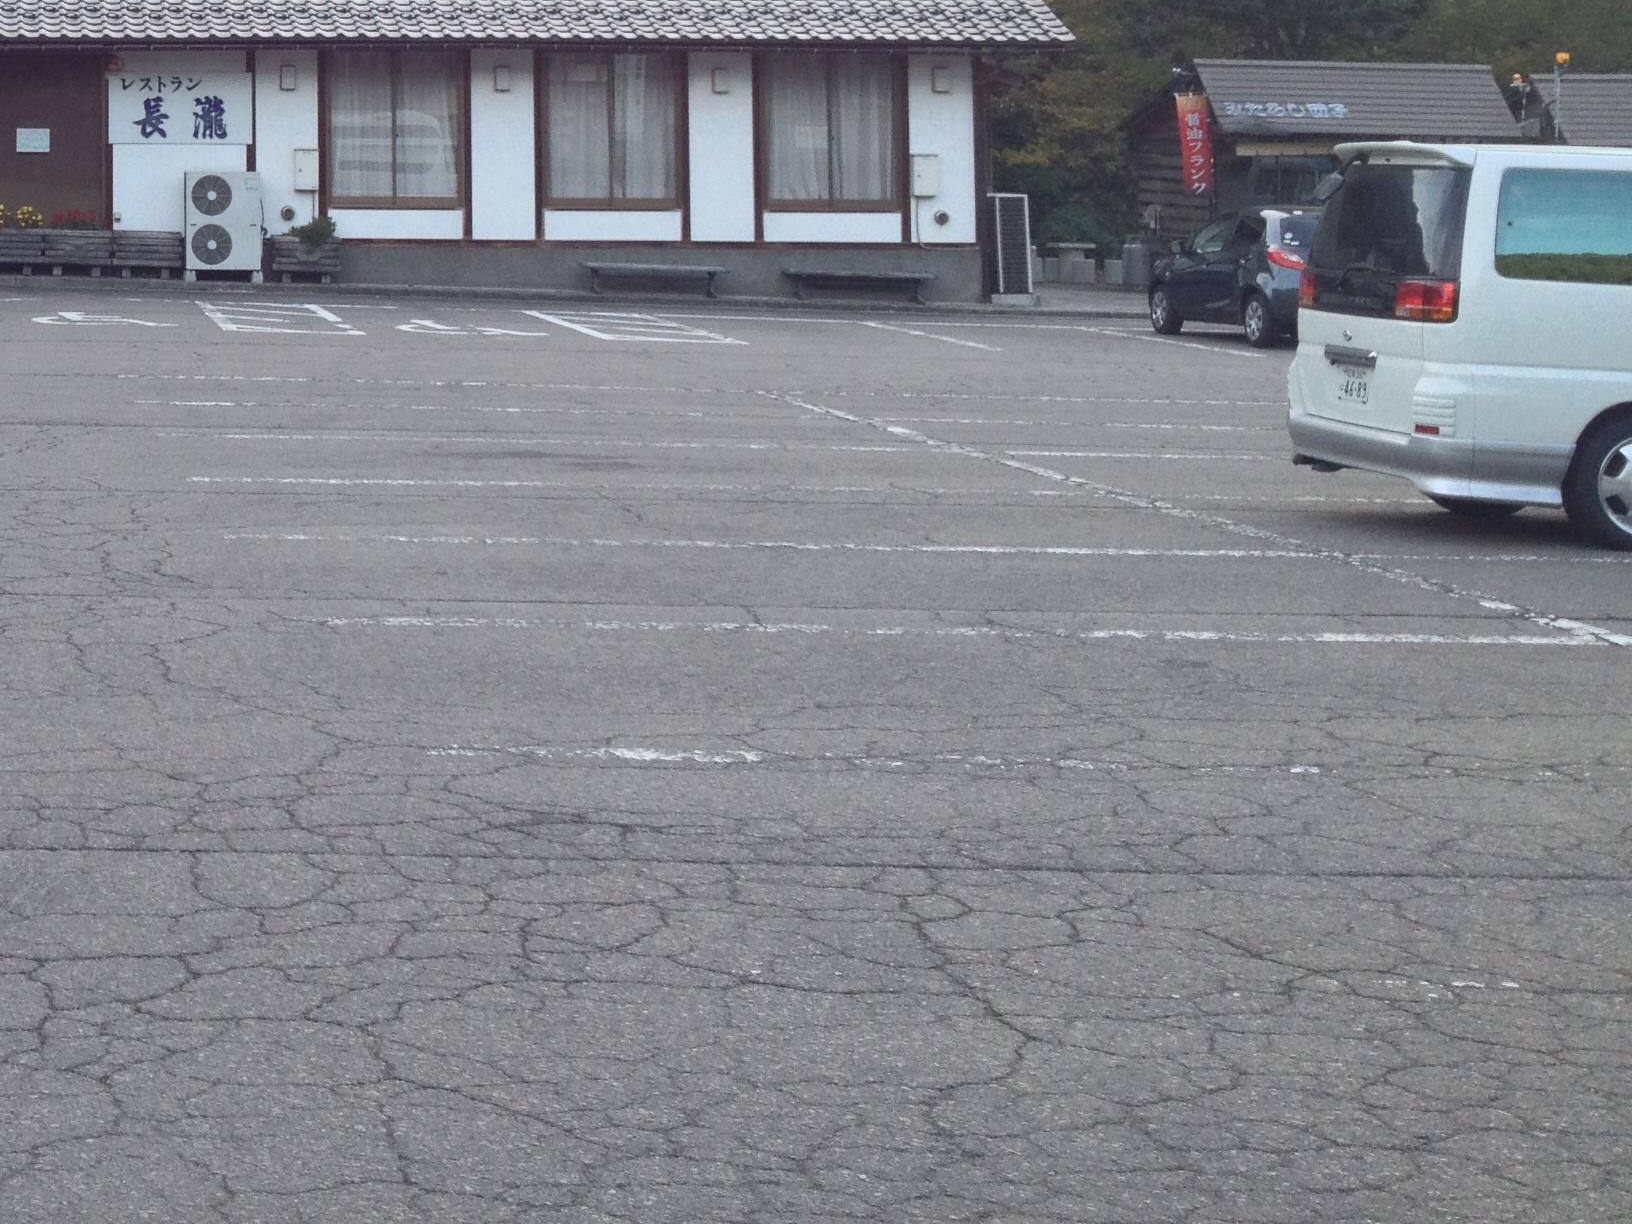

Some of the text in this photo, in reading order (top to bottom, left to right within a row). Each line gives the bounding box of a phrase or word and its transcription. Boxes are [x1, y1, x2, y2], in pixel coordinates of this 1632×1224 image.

[120, 76, 203, 93] レストラン
